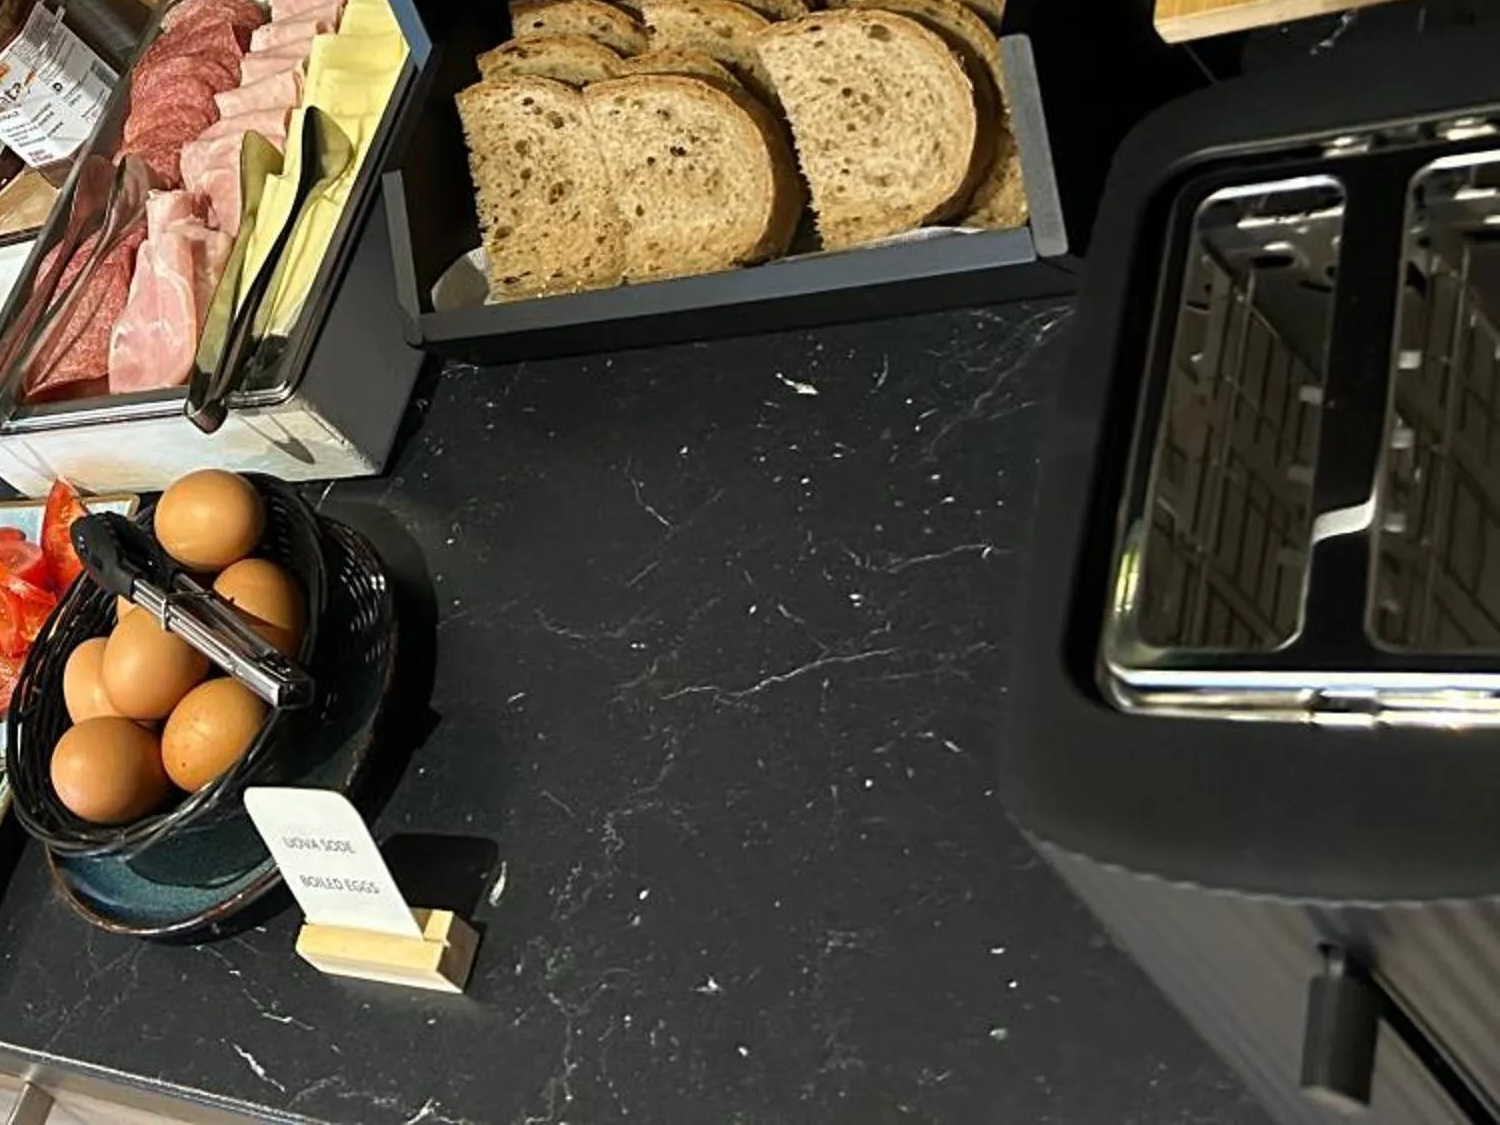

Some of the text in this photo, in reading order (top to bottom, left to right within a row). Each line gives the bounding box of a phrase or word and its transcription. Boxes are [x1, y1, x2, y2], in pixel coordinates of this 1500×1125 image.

[282, 835, 357, 855] UOVA SODE
[299, 874, 381, 895] BOILED EGGS
